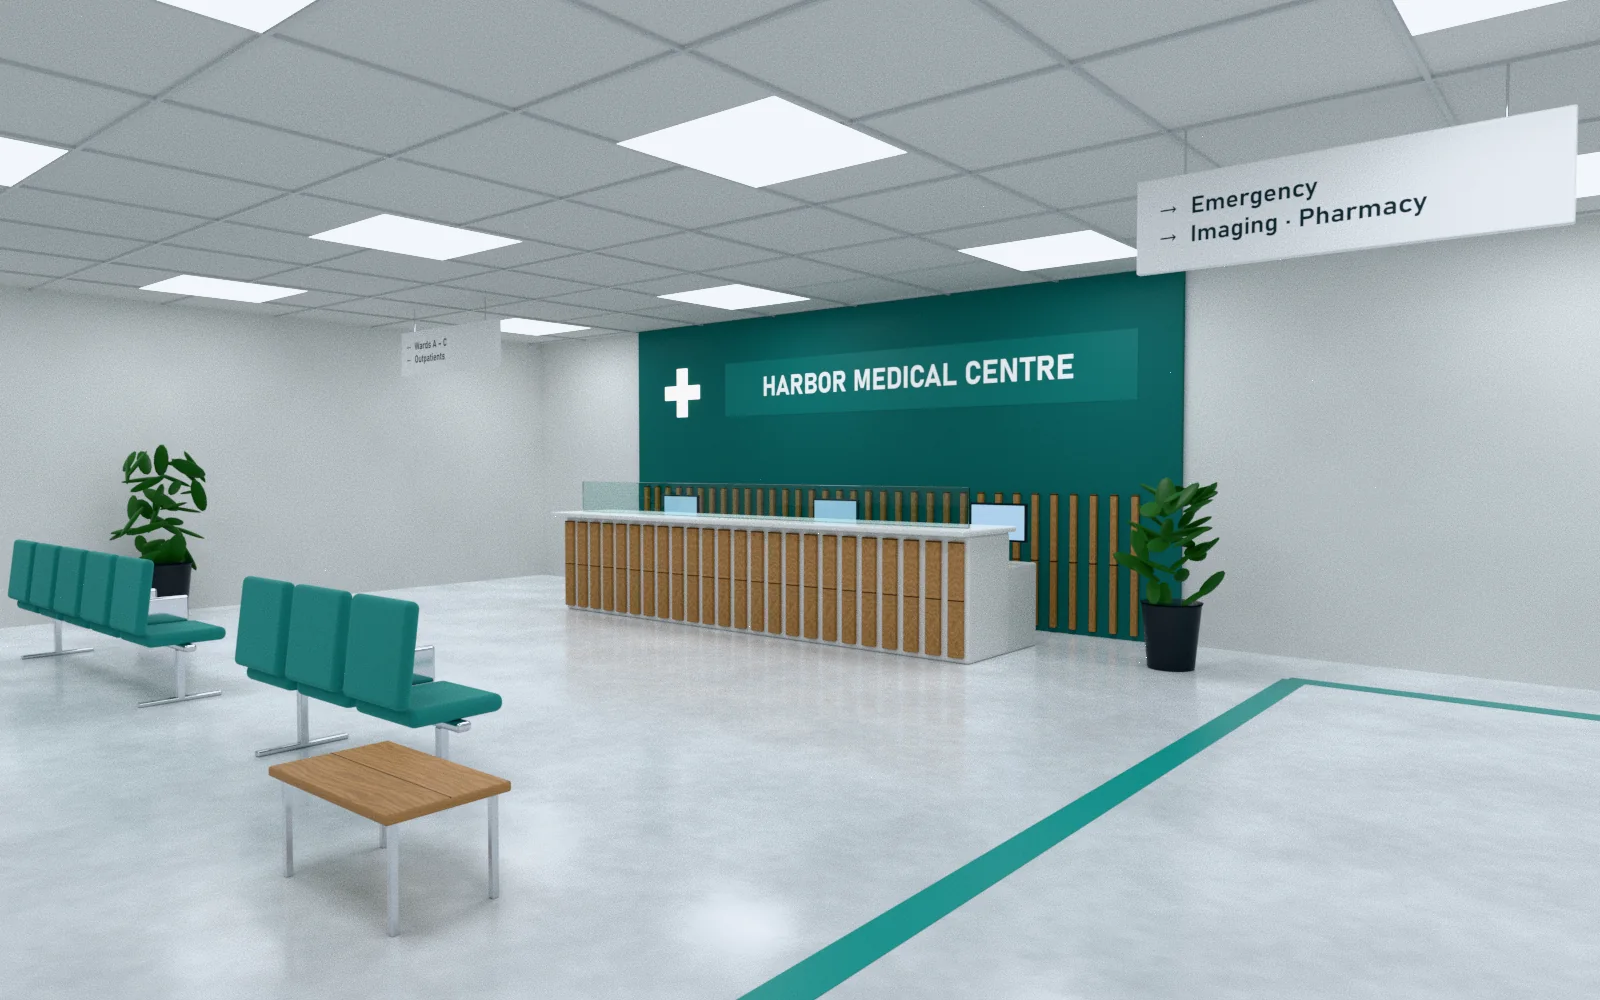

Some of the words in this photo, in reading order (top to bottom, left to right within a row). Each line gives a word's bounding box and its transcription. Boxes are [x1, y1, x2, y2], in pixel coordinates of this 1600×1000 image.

[1192, 181, 1318, 214] Emergency
[1191, 217, 1277, 242] Imaging
[1299, 196, 1428, 227] Pharmacy
[414, 341, 432, 350] Wards
[432, 340, 436, 348] A
[443, 338, 447, 346] C
[414, 353, 445, 364] Outpatients
[763, 370, 847, 397] HARBOR
[853, 362, 958, 391] MEDICAL
[965, 353, 1075, 385] CENTRE
